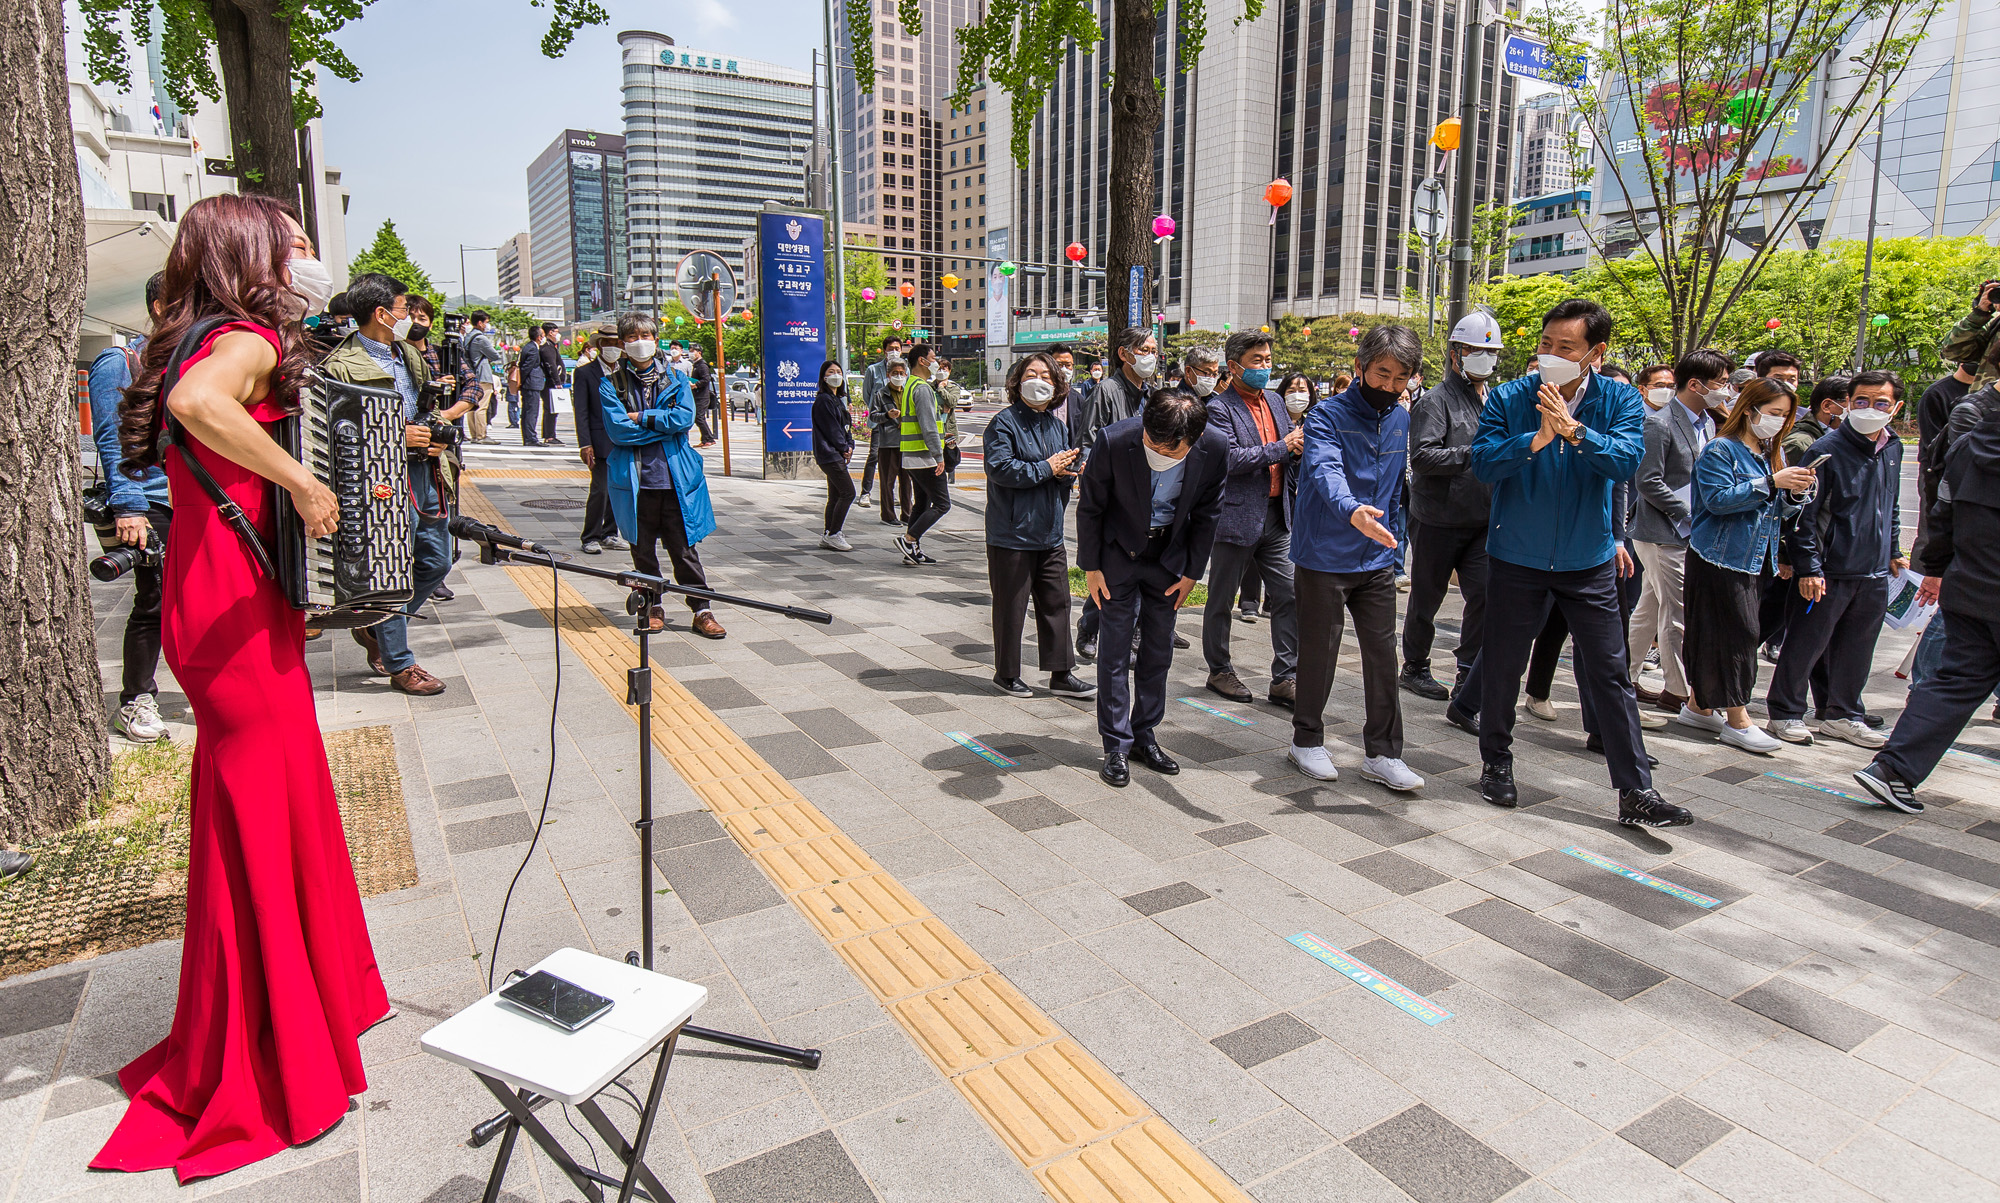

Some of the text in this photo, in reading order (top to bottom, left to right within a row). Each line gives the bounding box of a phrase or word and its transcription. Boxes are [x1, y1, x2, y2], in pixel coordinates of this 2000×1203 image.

[571, 138, 596, 147] KYOBO
[777, 243, 810, 254] 대한성공회
[796, 381, 818, 389] Embassy
[1372, 983, 1437, 1020] 안전거리를
